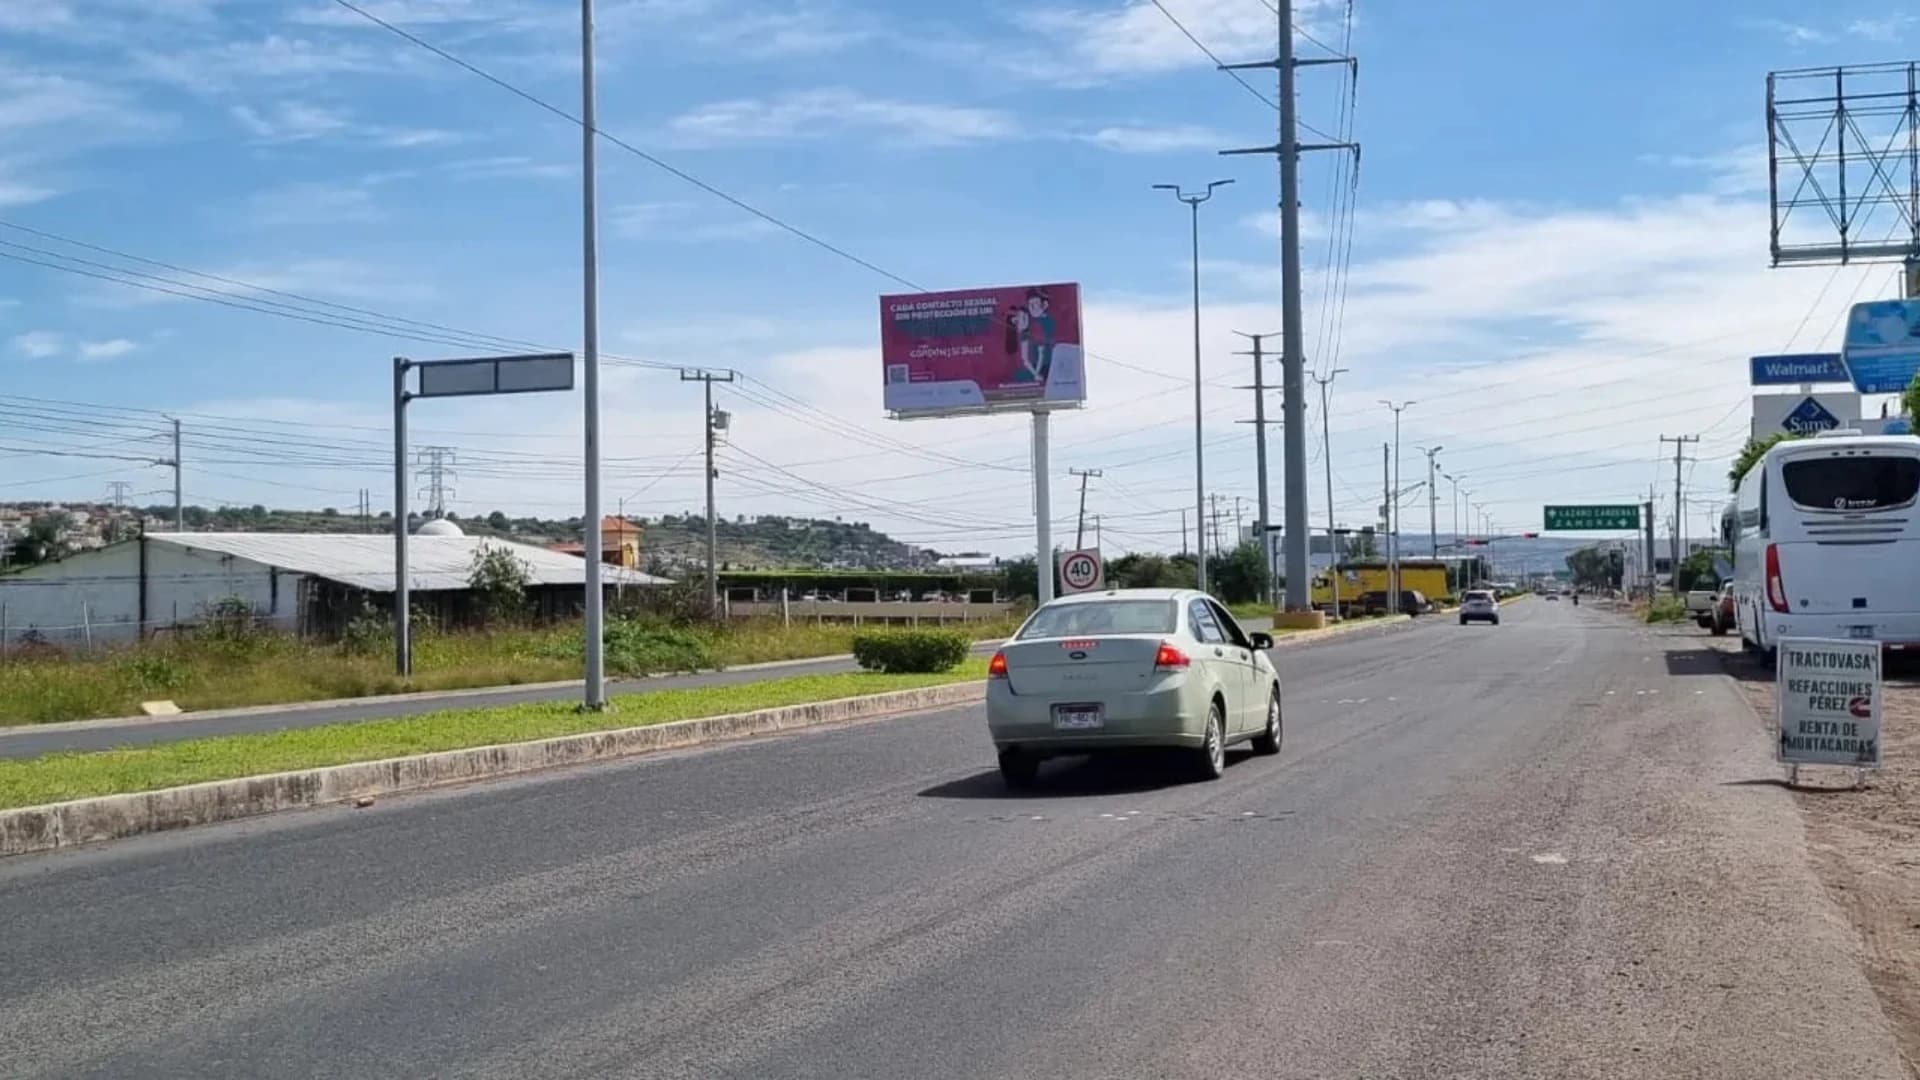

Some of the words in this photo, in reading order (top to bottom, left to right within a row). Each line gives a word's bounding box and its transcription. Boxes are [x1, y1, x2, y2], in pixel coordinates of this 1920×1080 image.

[890, 303, 914, 312] CADA
[916, 299, 962, 310] CONTACTO
[963, 297, 997, 307] SEXUAL
[1765, 362, 1828, 376] Walmart
[1554, 519, 1614, 528] ZAMORA
[1071, 560, 1090, 576] 40
[1789, 651, 1871, 670] TRACTOVASA
[1788, 679, 1872, 697] REFACCIONES
[1799, 720, 1838, 736] RENTA
[1843, 722, 1859, 737] DE
